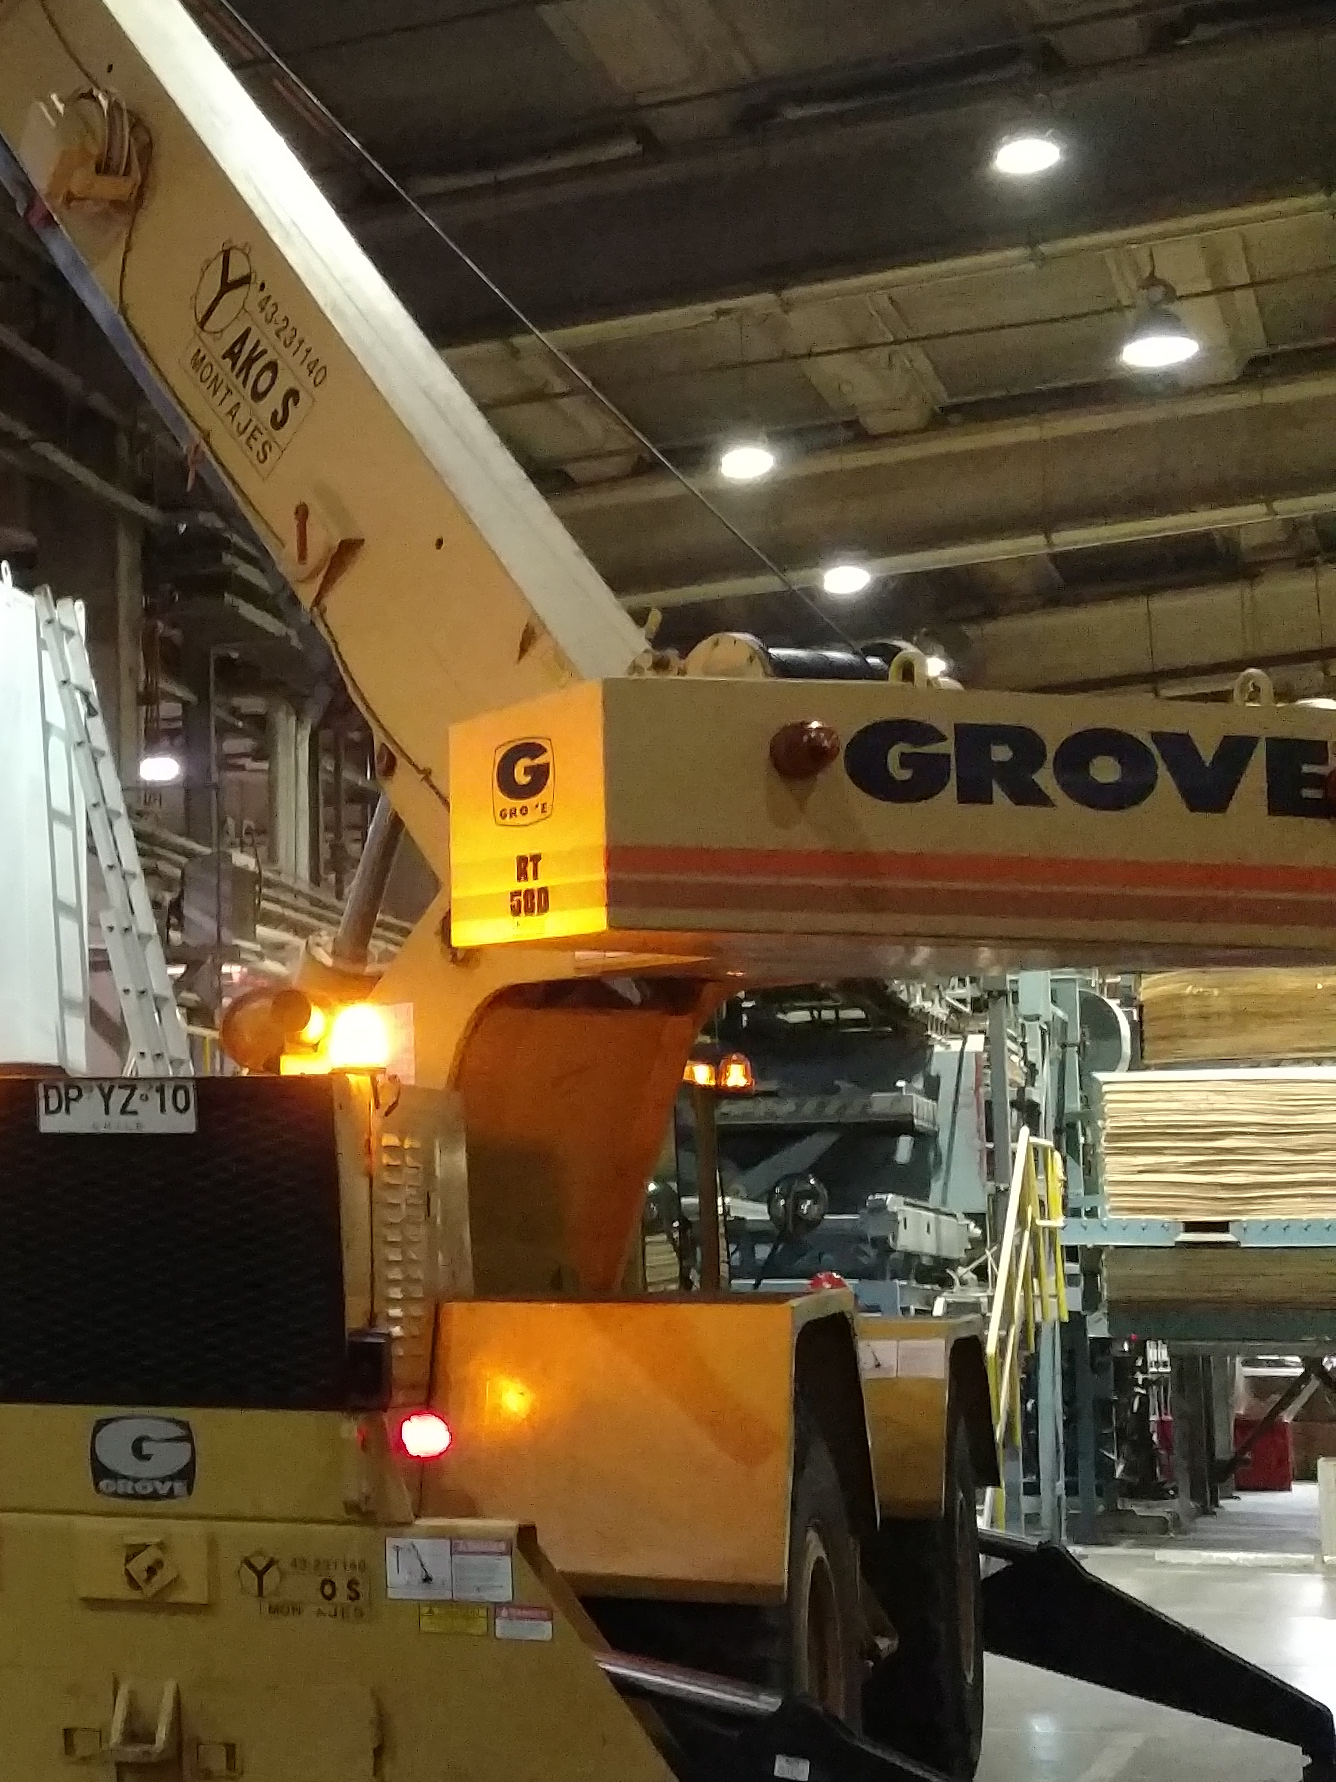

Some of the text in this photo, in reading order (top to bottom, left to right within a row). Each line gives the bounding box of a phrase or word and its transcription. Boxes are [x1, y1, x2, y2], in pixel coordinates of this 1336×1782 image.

[257, 293, 327, 388] 43-231140
[190, 347, 273, 464] MONTAJES
[498, 801, 548, 821] GROE
[843, 718, 1332, 819] GROVE
[515, 852, 543, 883] RT
